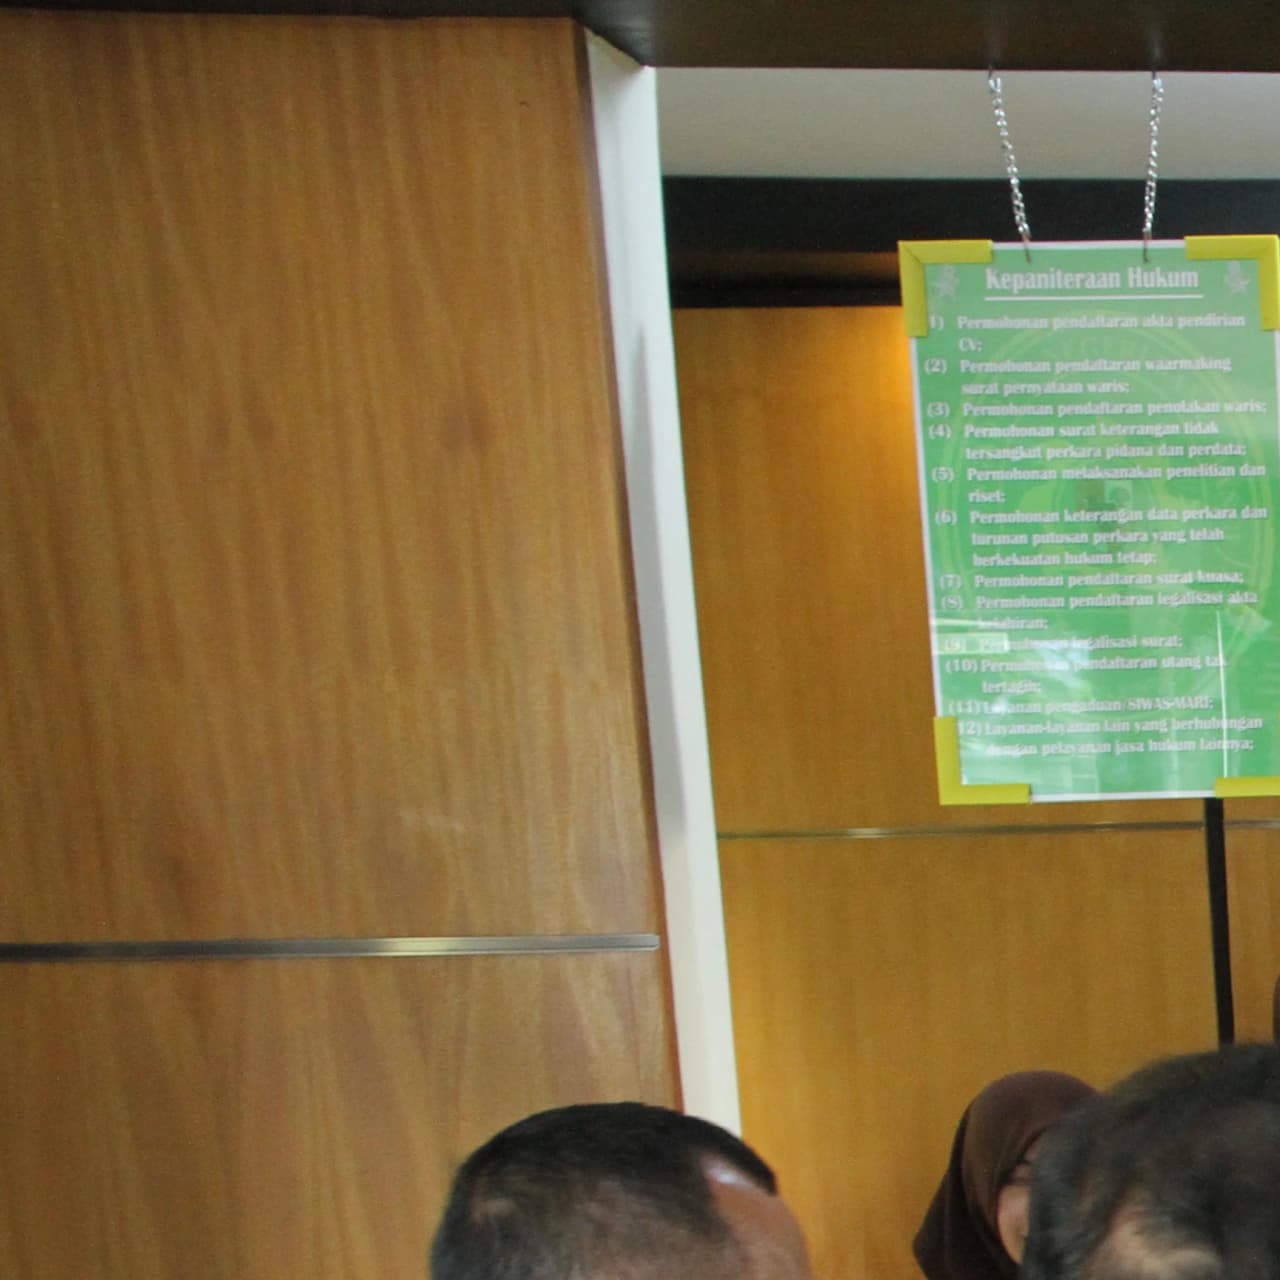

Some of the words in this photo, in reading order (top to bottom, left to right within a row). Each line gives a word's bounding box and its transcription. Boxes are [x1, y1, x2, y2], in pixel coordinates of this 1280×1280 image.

[985, 268, 1121, 293] Kepaniteraan
[1128, 267, 1198, 288] Hukum
[928, 316, 944, 329] 1)
[984, 700, 1041, 715] Laanan
[959, 720, 982, 735] 12)
